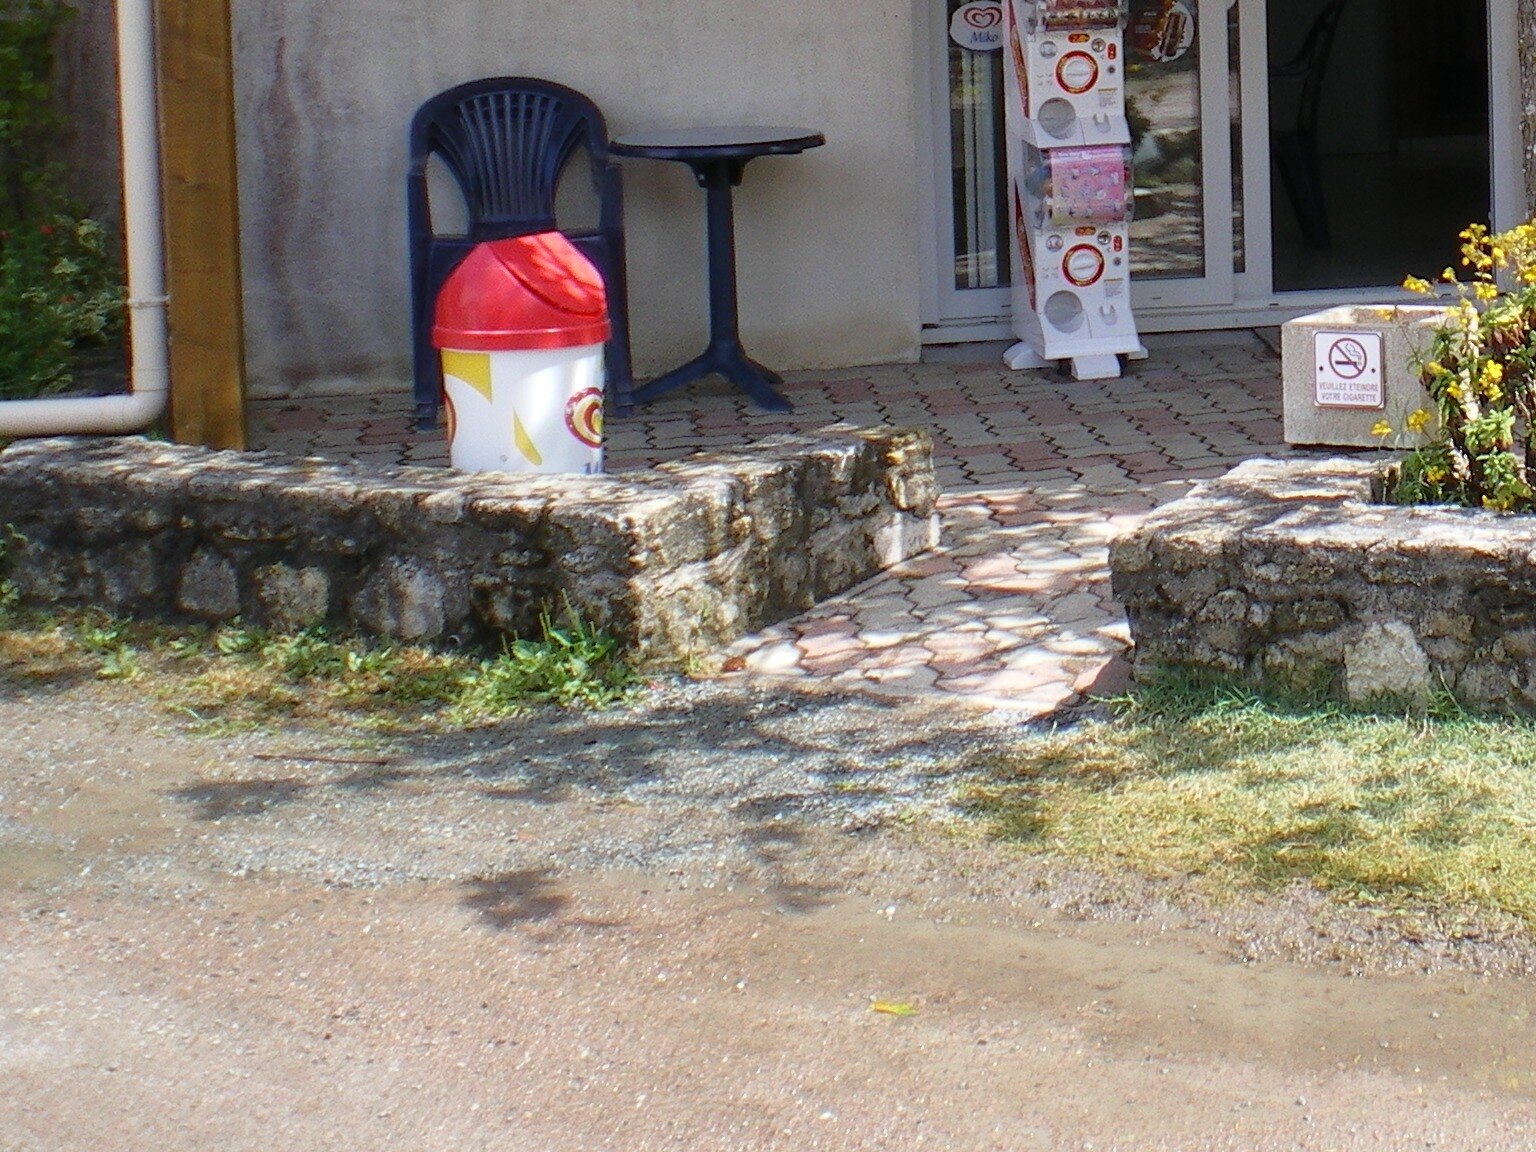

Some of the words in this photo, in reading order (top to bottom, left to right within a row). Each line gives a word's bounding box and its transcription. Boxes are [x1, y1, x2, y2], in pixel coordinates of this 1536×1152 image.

[970, 31, 999, 44] Miko
[1319, 382, 1347, 391] VEUILLEZ
[1322, 392, 1342, 401] VOTRE
[1343, 393, 1377, 402] CIGARETTE
